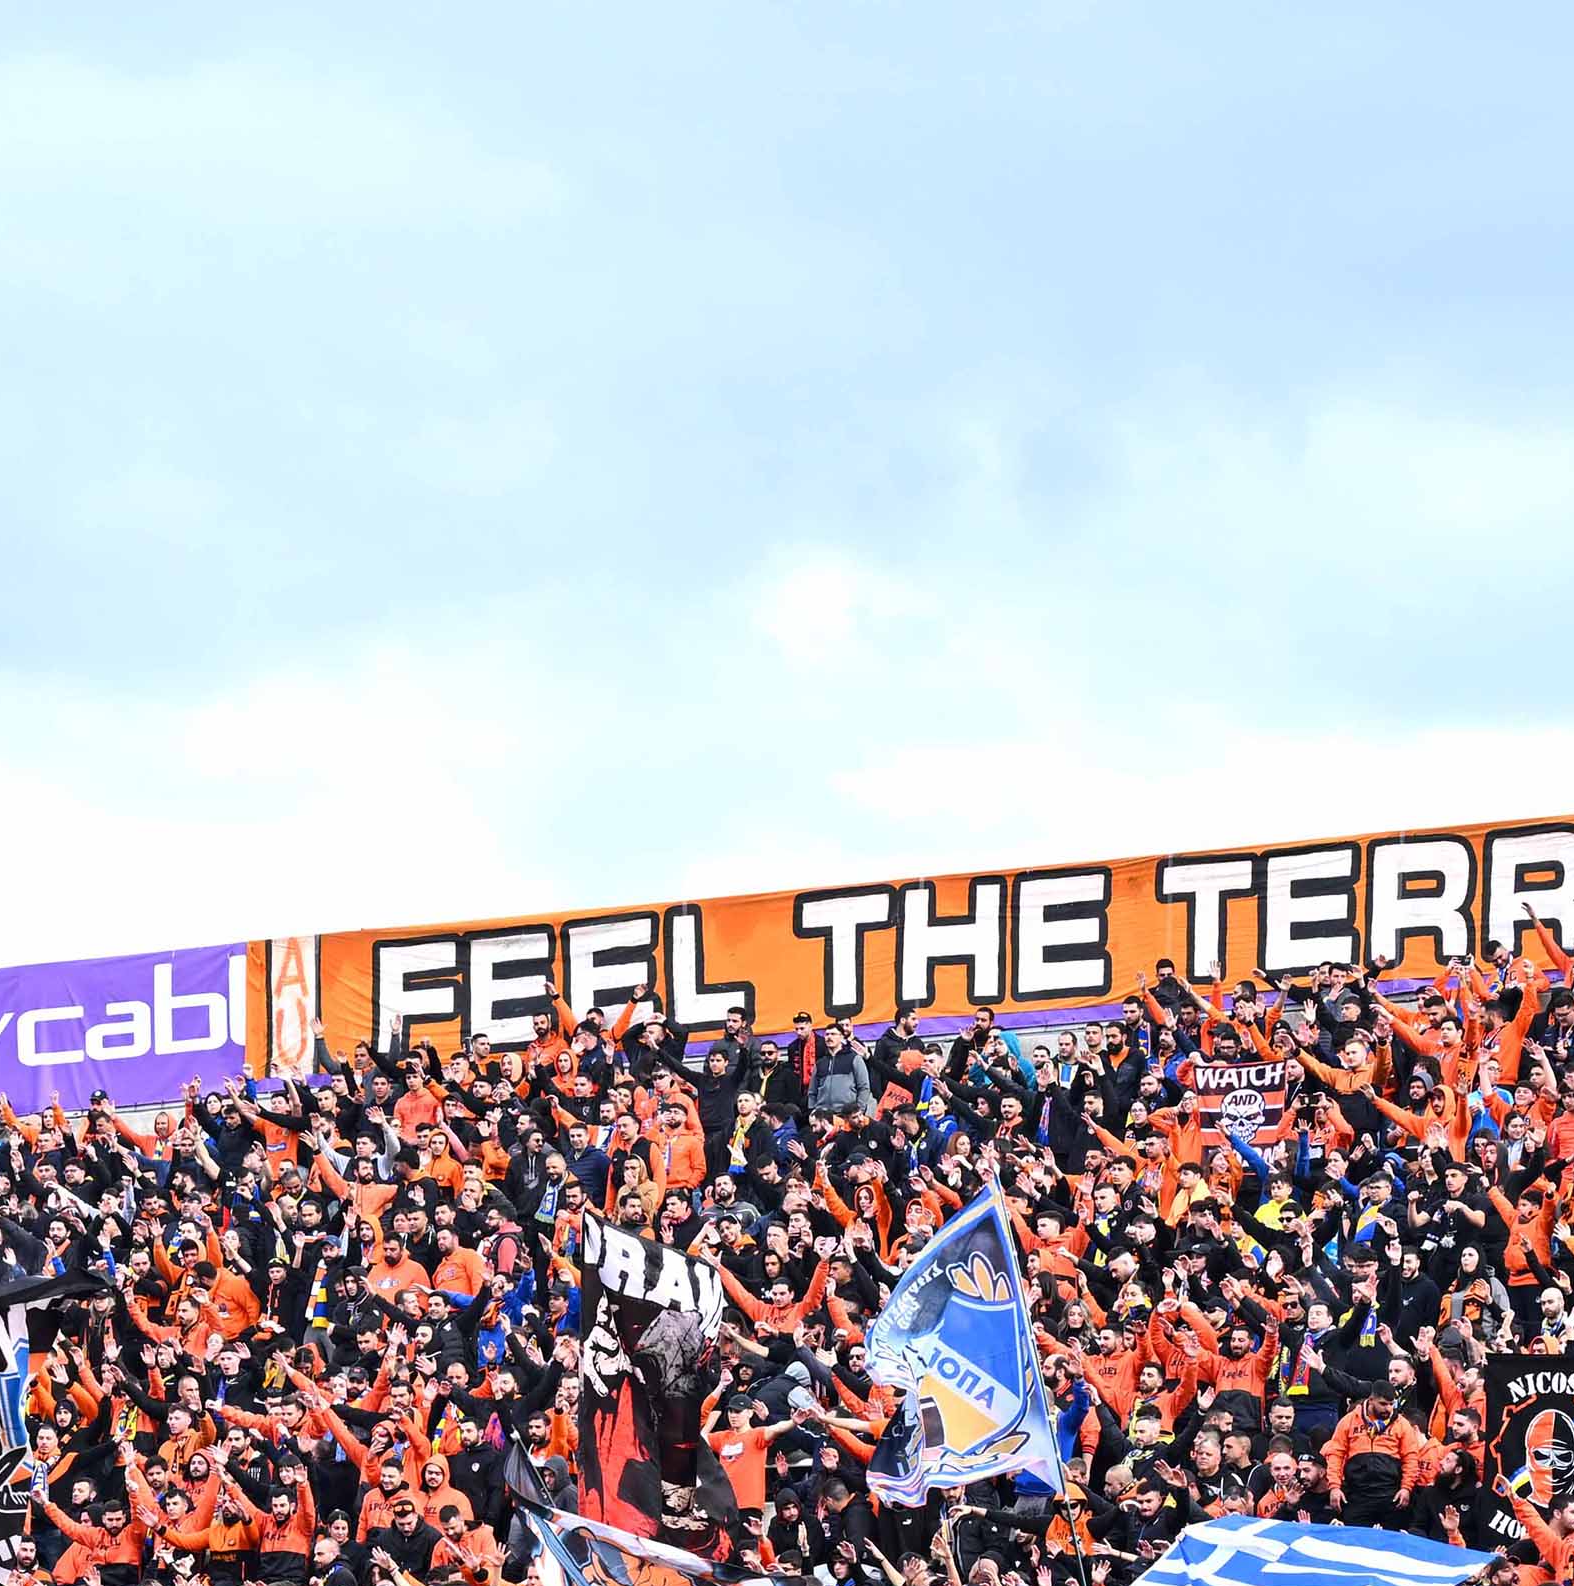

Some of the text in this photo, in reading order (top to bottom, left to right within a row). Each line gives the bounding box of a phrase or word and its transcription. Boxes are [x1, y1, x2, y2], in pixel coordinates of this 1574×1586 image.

[371, 905, 756, 1062] FEEL
[794, 867, 1112, 1016] THE
[1196, 1061, 1284, 1090] WATCH
[1228, 1094, 1257, 1106] AND
